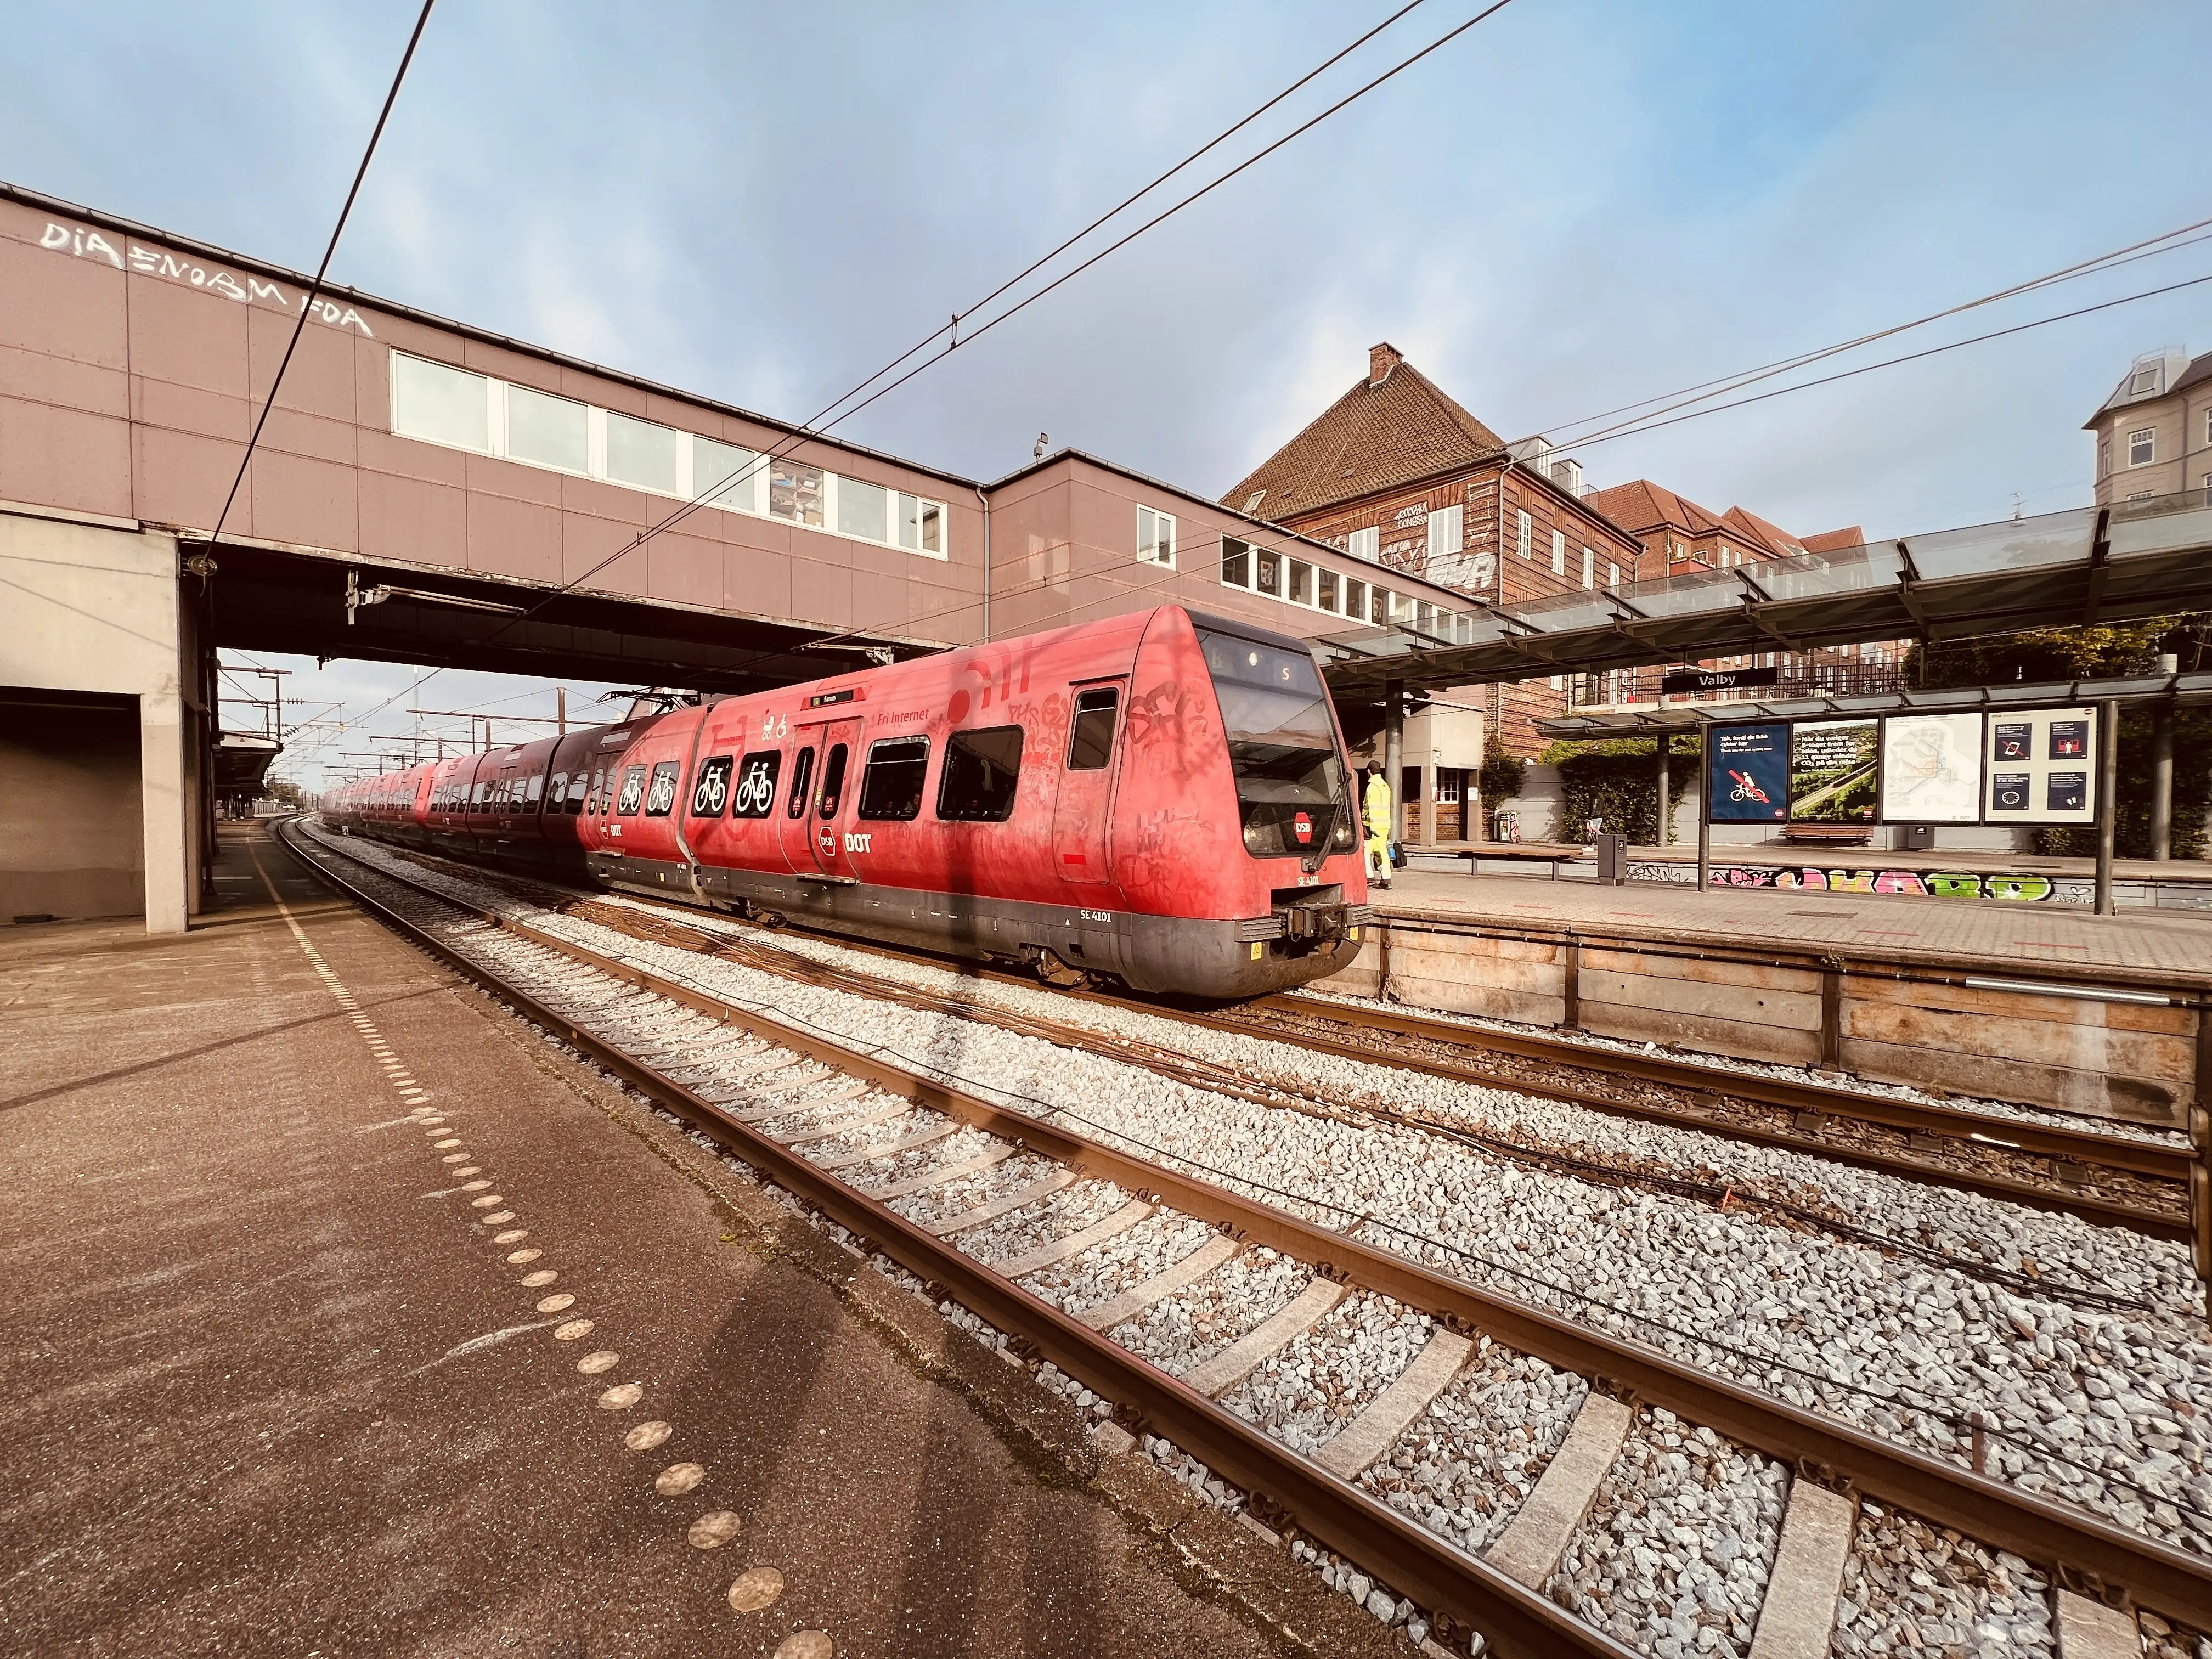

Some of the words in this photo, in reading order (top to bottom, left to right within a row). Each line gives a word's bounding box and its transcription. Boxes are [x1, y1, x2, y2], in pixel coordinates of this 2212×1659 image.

[1699, 674, 1736, 686] Valby
[878, 713, 888, 726] Fri
[891, 708, 930, 724] Internet
[1295, 822, 1311, 833] DSB
[820, 837, 833, 846] DSB
[845, 833, 872, 853] DOT
[1297, 877, 1306, 887] SE
[1306, 876, 1320, 885] 4101
[1080, 910, 1090, 920] SE
[1092, 911, 1111, 922] 4101
